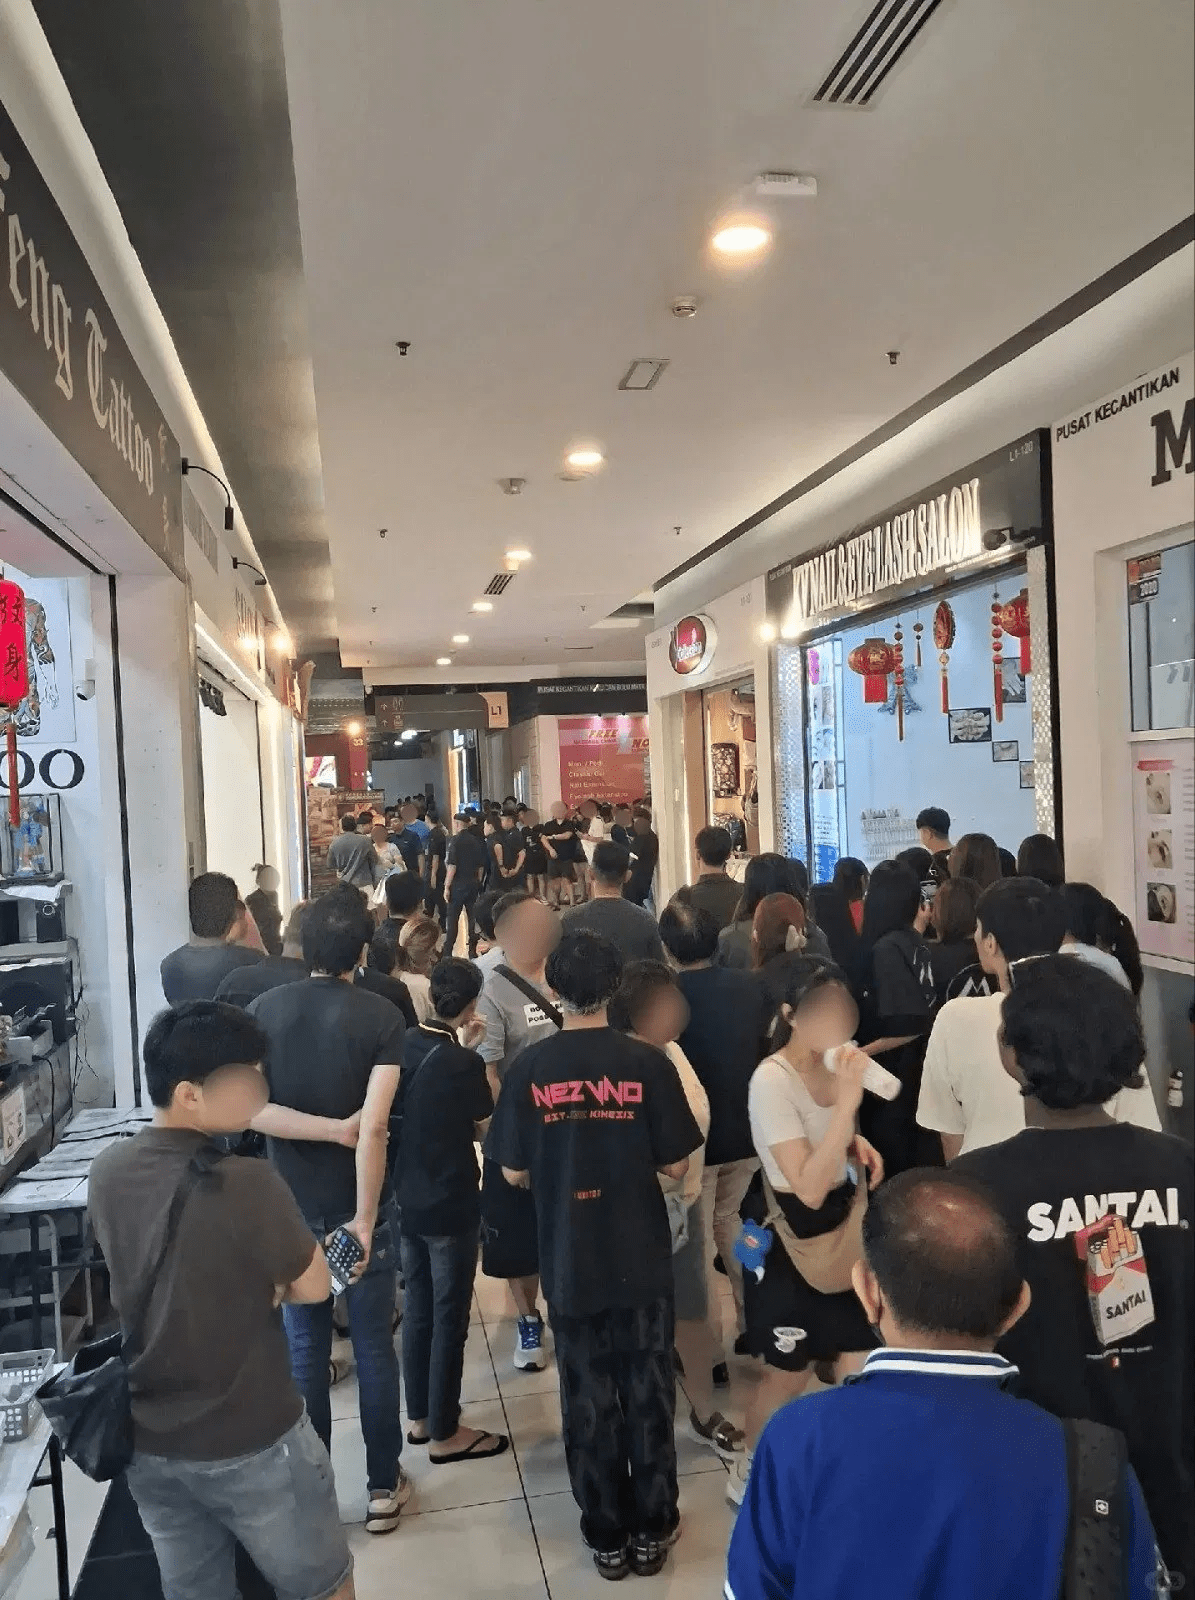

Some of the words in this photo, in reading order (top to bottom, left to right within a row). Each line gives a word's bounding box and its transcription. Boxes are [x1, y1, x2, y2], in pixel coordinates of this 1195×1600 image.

[1056, 411, 1092, 442] PUSAT
[1094, 366, 1180, 424] KECANTIKAN
[1150, 396, 1195, 487] M
[916, 477, 981, 576] SALON
[491, 705, 502, 716] L1
[1027, 1187, 1180, 1242] SANTAI
[1105, 1289, 1147, 1320] SANTAI
